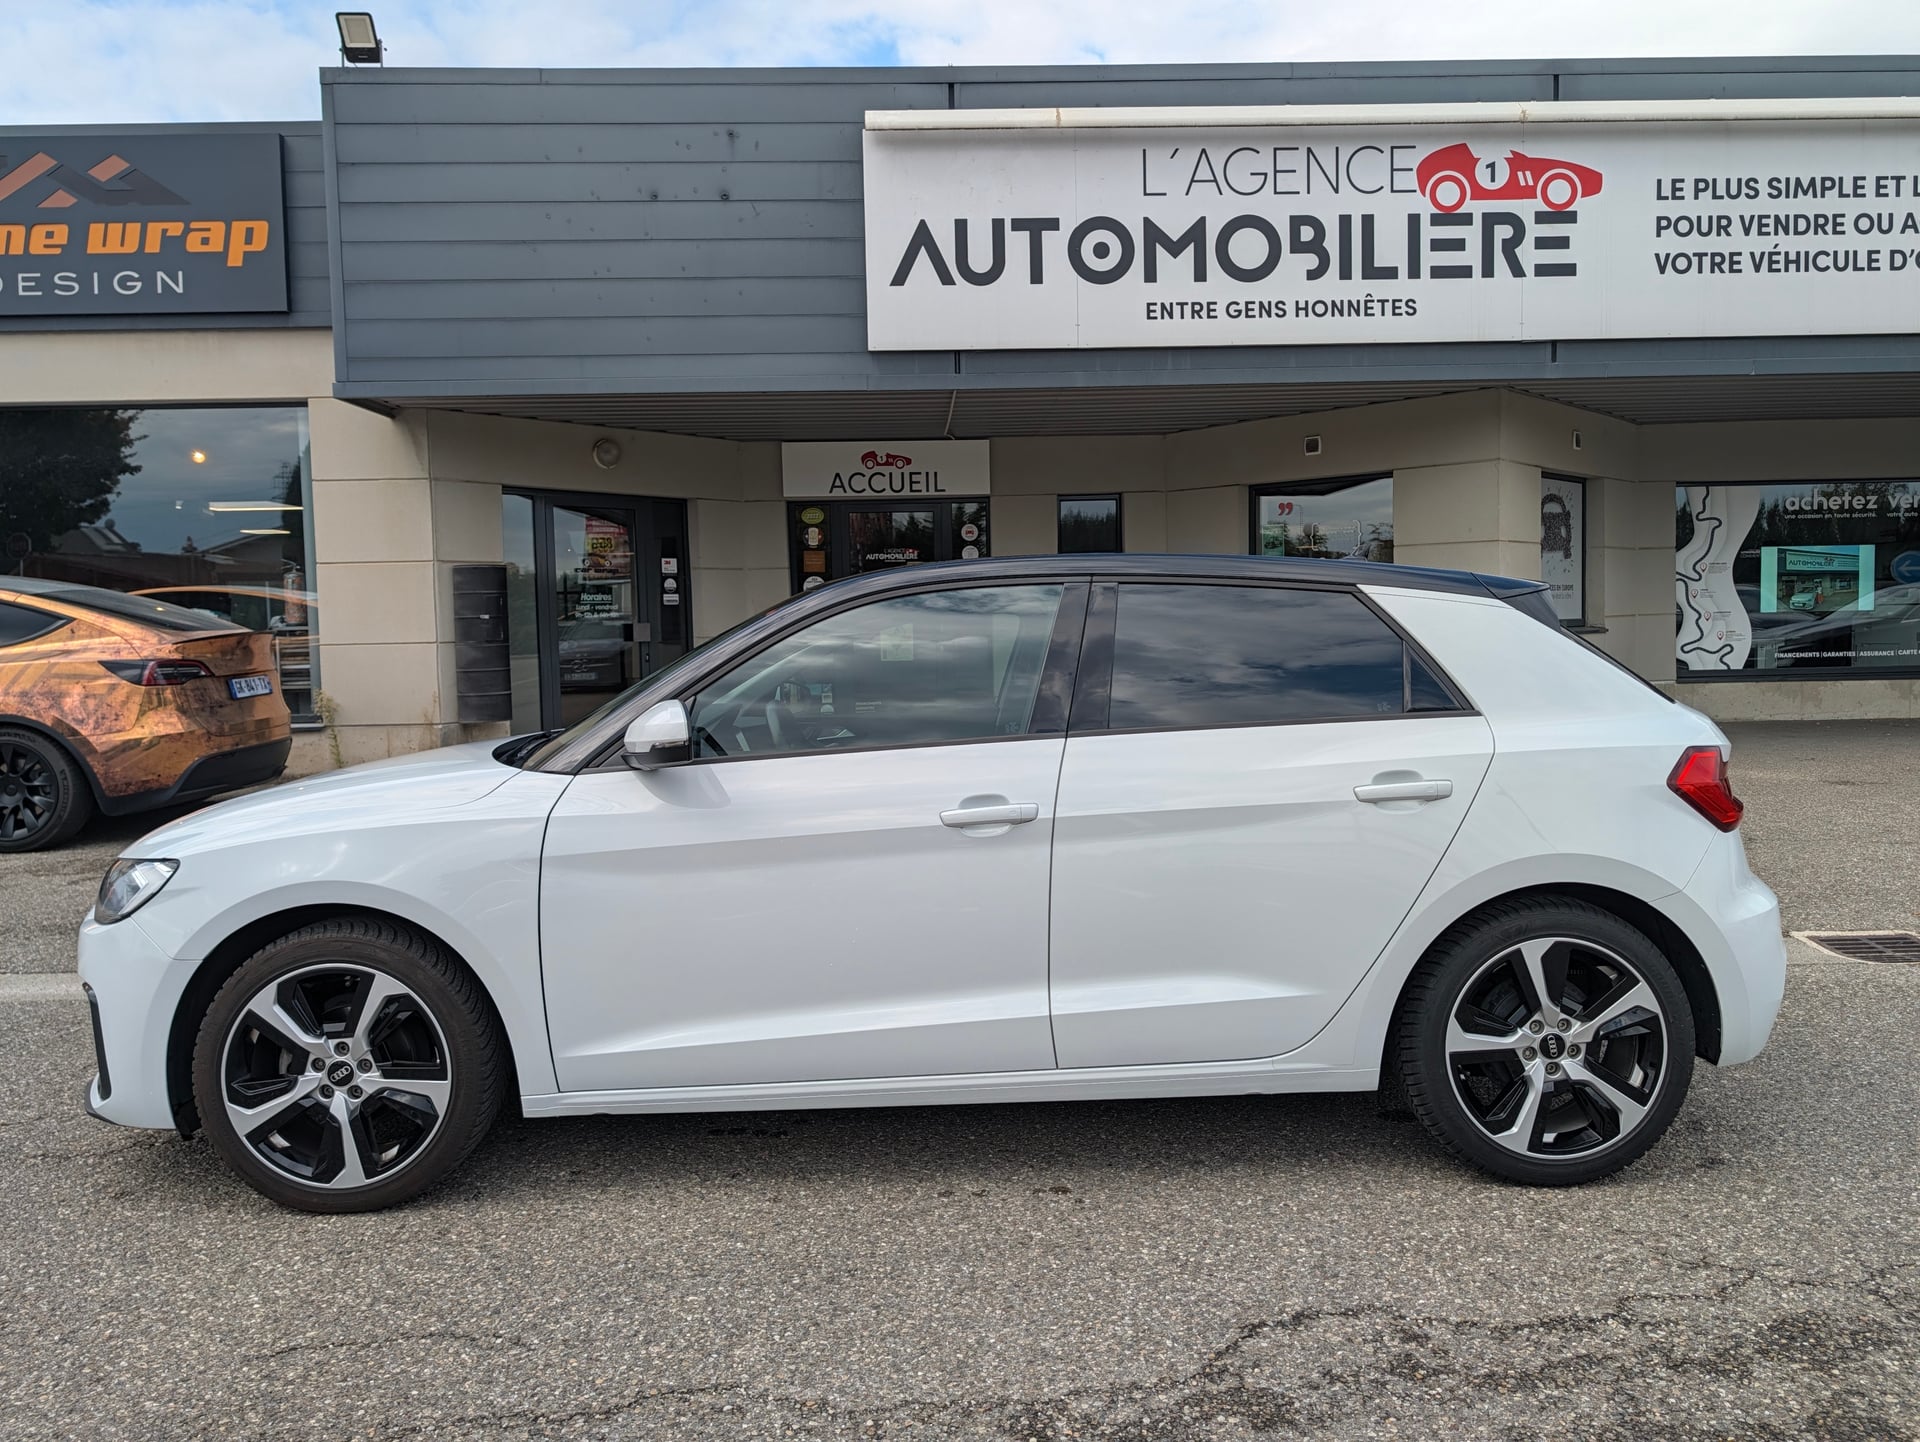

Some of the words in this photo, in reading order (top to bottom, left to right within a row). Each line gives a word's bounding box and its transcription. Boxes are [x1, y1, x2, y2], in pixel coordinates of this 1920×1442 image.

[1142, 145, 1417, 197] L'AGENCE
[1656, 178, 1685, 200] LE
[1694, 177, 1759, 200] PLUS
[1767, 176, 1866, 199] SIMPLE
[1875, 176, 1906, 198] ET
[1656, 215, 1732, 238] POUR
[1739, 213, 1846, 237] VENDRE
[1853, 212, 1893, 235] OU
[87, 220, 269, 267] wrap
[1654, 252, 1743, 275] VOTRE
[1749, 243, 1881, 274] VÉHICULE
[0, 270, 184, 296] ESIGN
[1146, 301, 1219, 321] ENTRE
[1225, 300, 1288, 320] GENS
[1294, 293, 1417, 319] HONNÊTES
[828, 471, 947, 494] ACCUEIL
[1785, 488, 1878, 509] achetez
[580, 592, 612, 601] Horaires
[1822, 650, 1856, 658] GARANTIES
